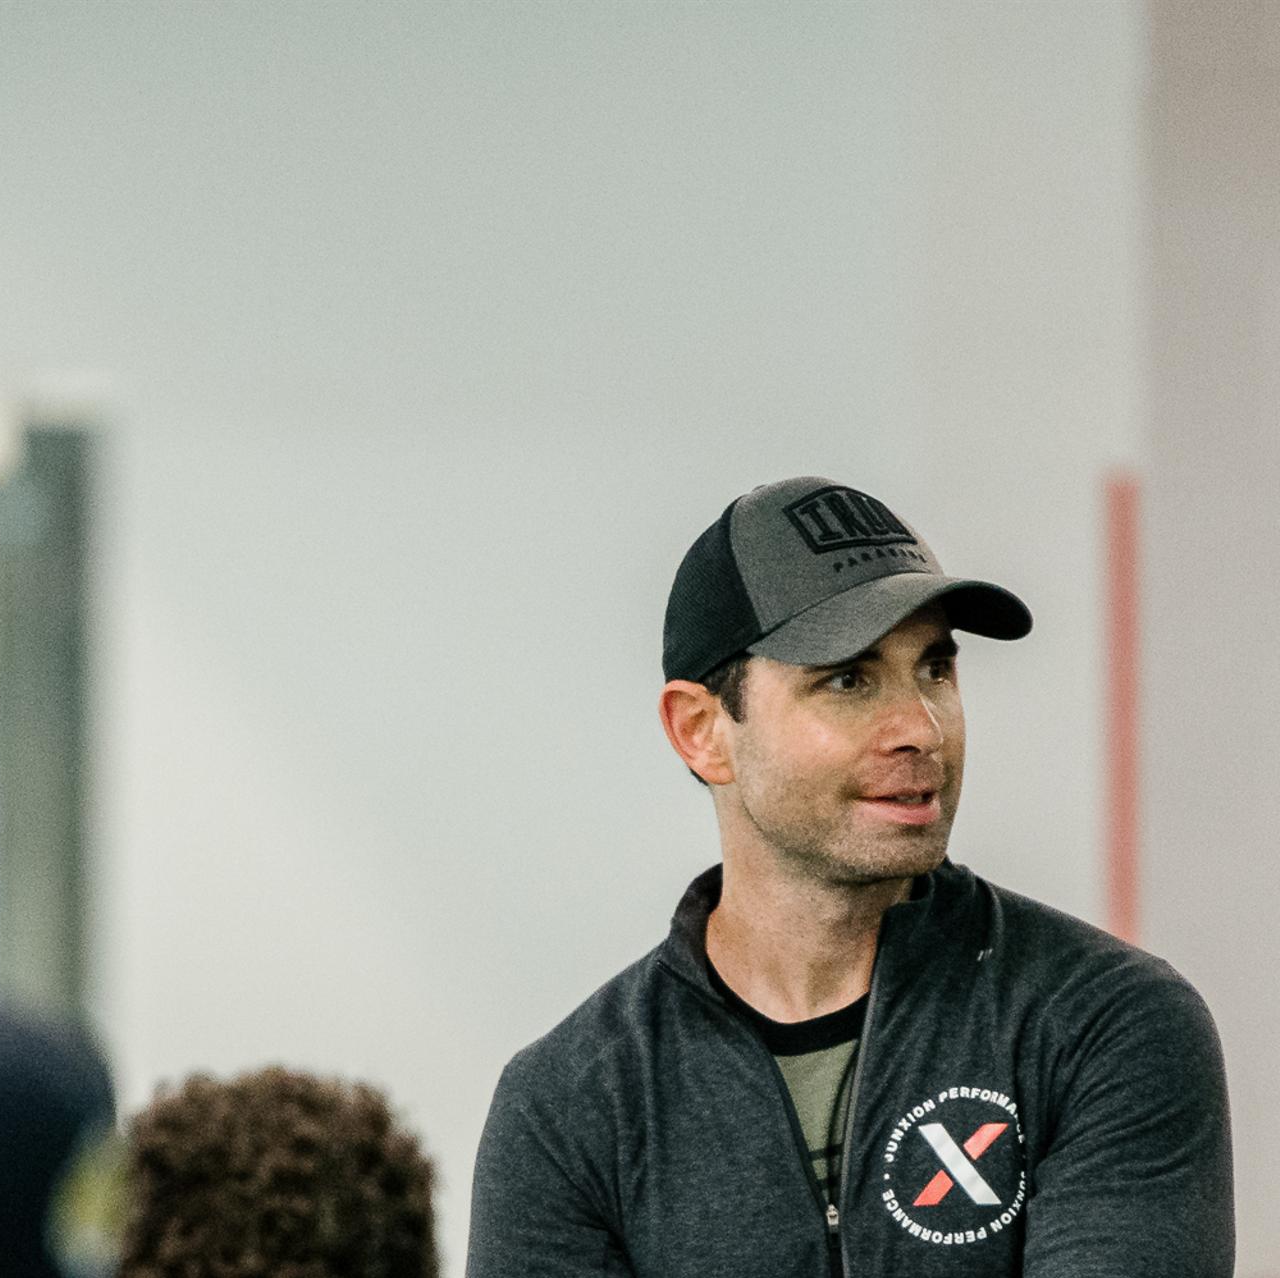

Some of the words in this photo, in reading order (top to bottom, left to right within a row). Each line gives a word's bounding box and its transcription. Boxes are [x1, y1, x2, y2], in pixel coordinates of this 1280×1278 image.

[884, 1098, 937, 1163] JUNXION
[938, 1086, 1025, 1144] PERFORMACE
[882, 1188, 988, 1245] PERFORMANCE
